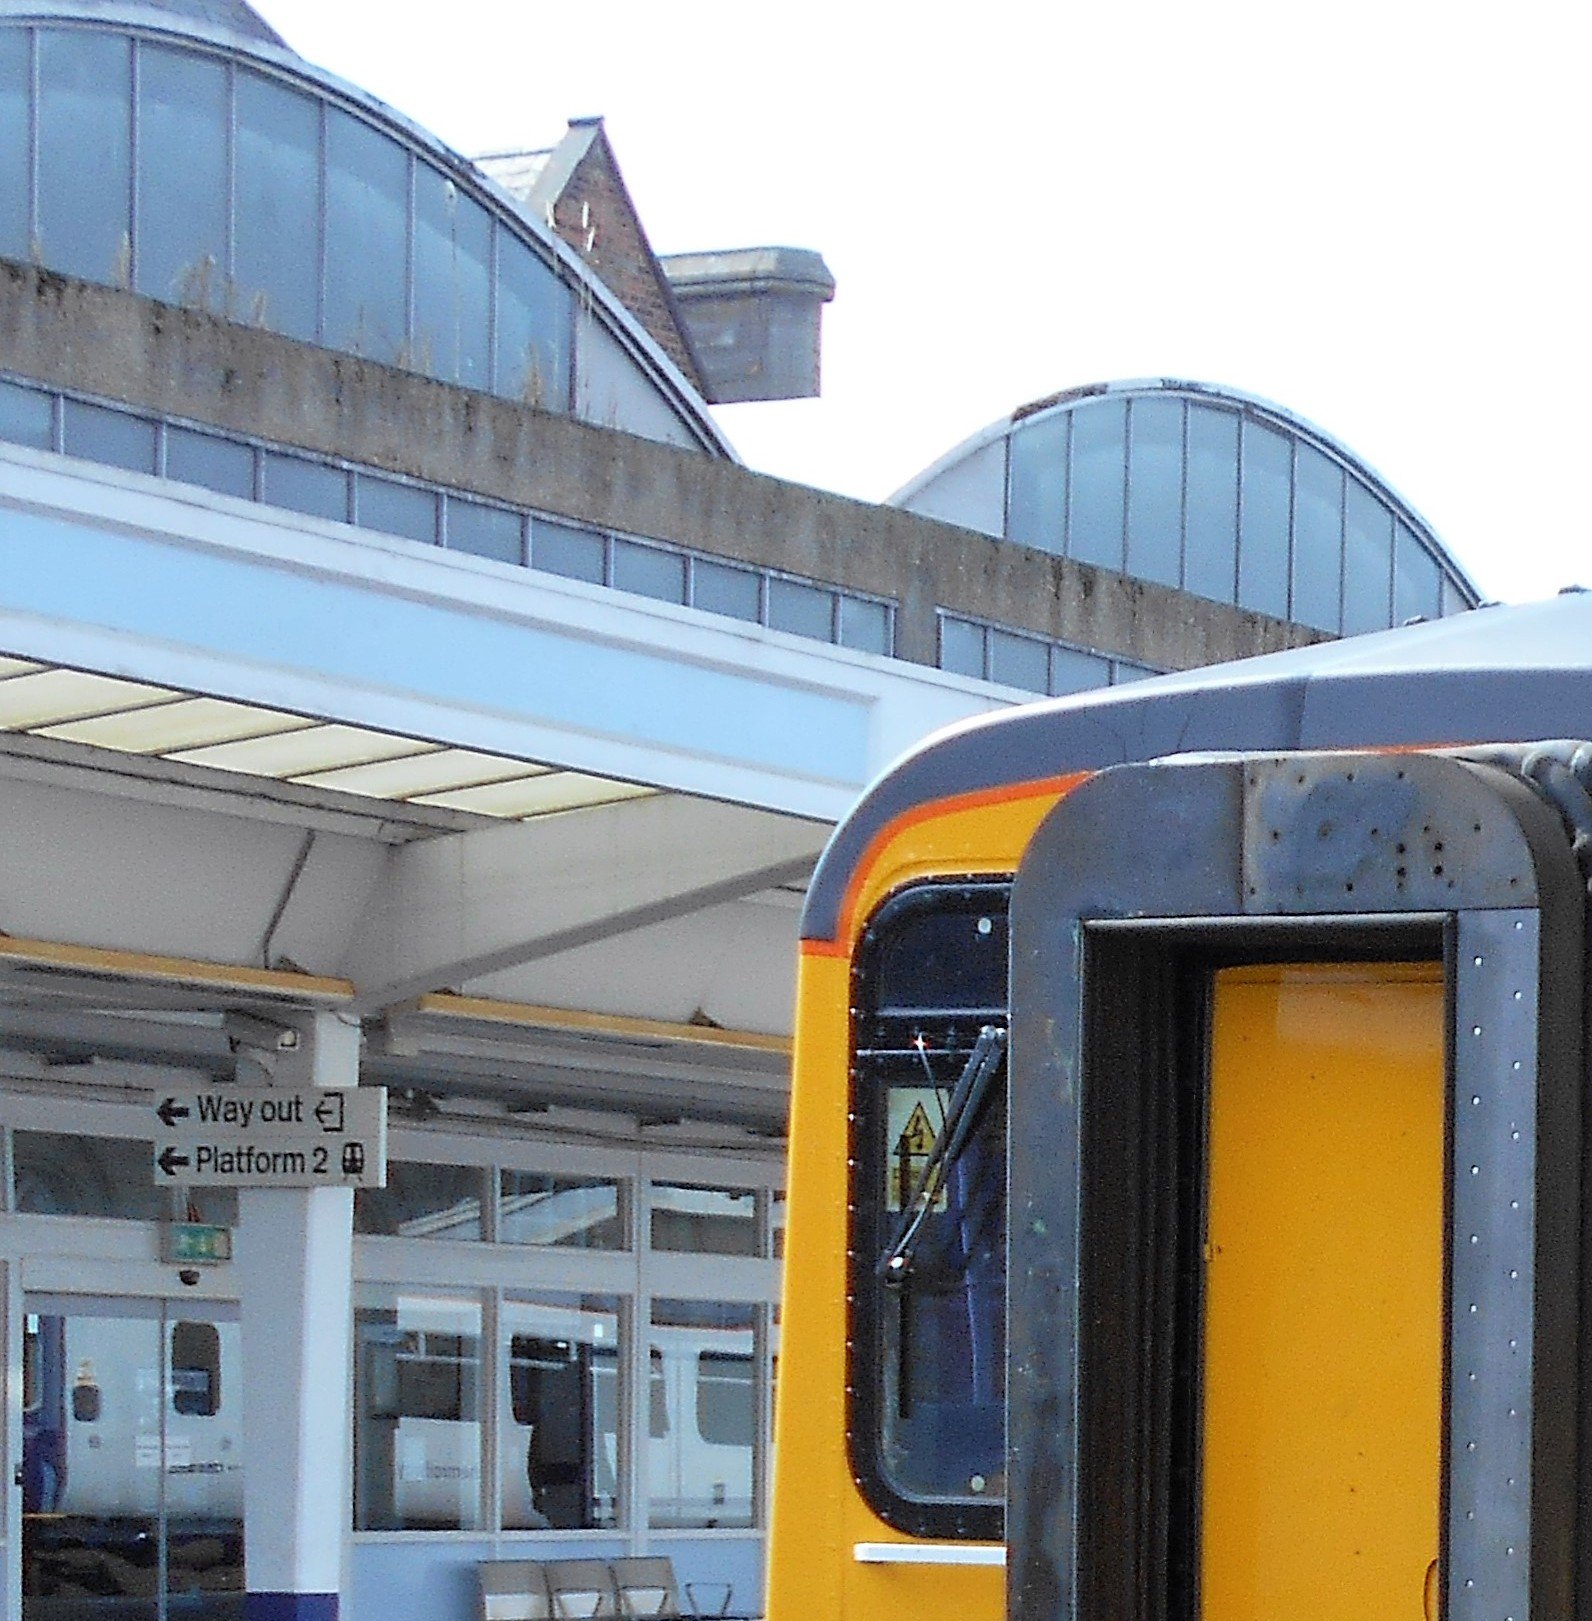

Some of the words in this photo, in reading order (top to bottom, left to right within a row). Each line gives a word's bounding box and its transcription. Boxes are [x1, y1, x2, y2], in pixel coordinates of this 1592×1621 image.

[197, 1094, 254, 1128] Way
[261, 1094, 303, 1122] out
[196, 1145, 305, 1174] Platform
[312, 1148, 328, 1175] 2
